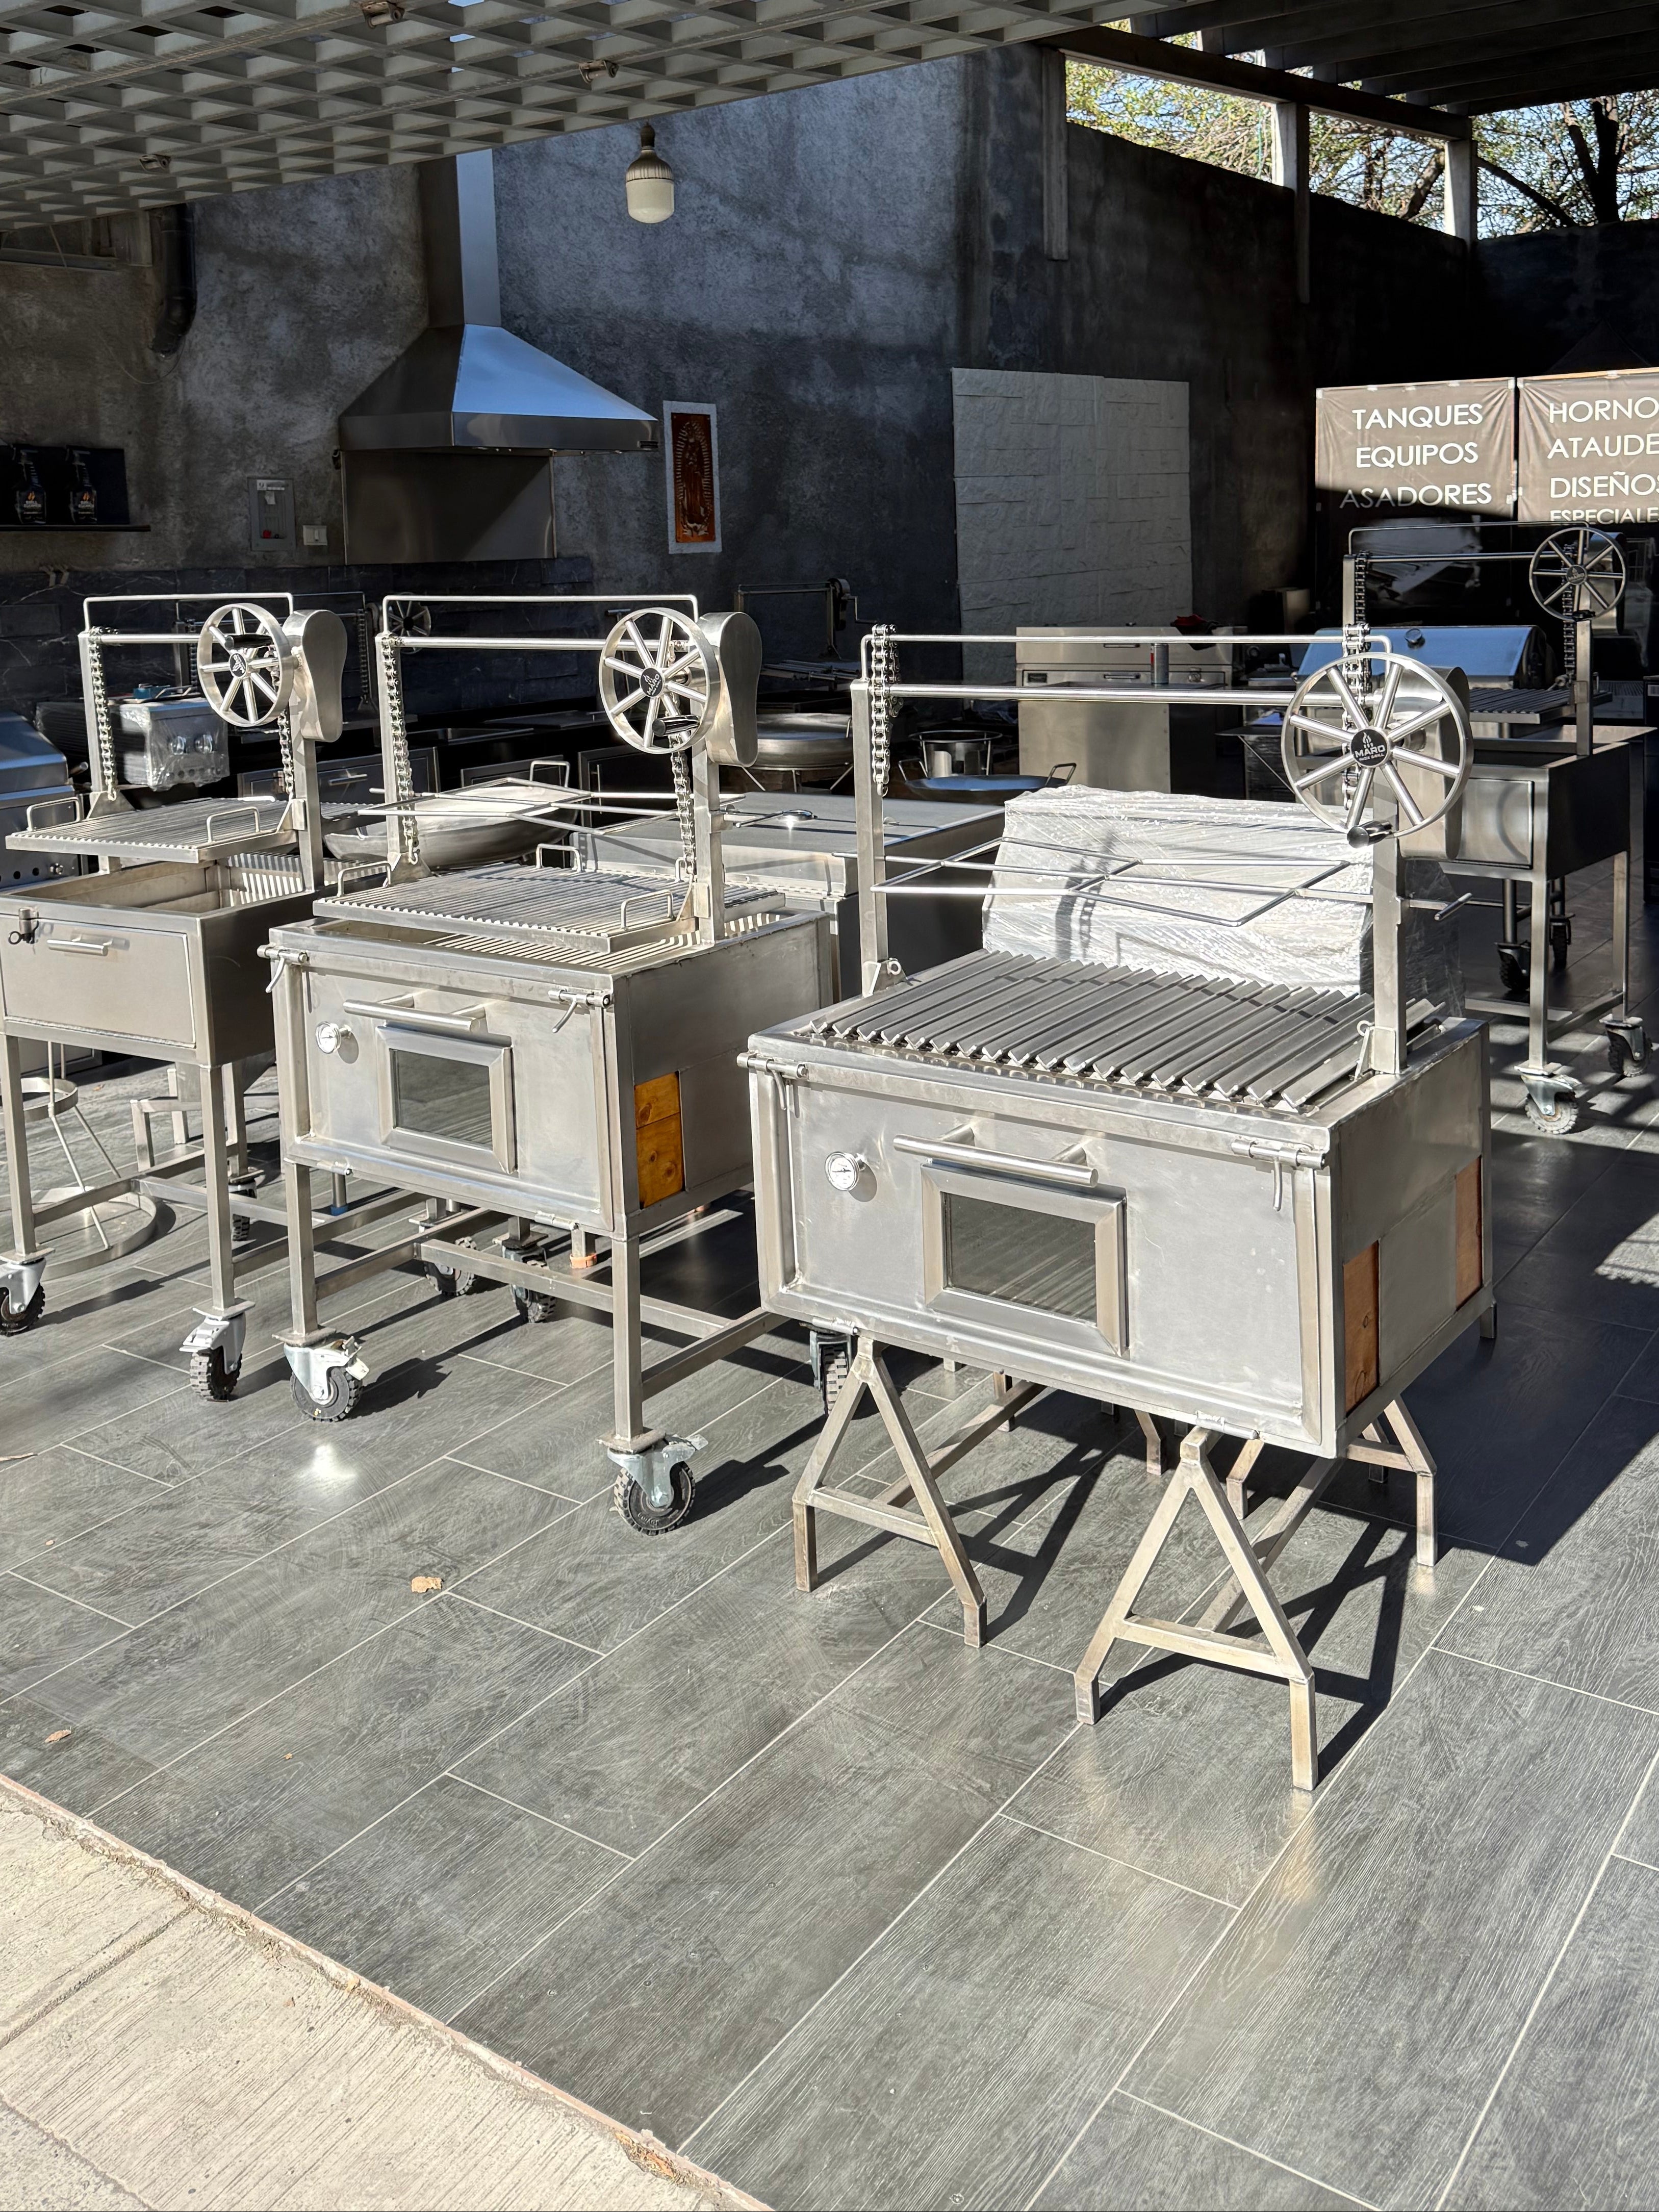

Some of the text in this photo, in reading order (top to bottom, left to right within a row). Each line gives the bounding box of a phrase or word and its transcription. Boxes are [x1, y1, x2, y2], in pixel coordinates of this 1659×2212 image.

[1352, 403, 1484, 430] TANQUES
[1549, 396, 1659, 423] HORNO
[1356, 442, 1479, 468] EQUIPOS
[1547, 433, 1659, 459] ATAUDE
[1339, 482, 1492, 508] ASADORES
[1550, 471, 1659, 498] DISEÑO
[1549, 507, 1659, 525] ESPECIALE
[647, 674, 660, 695] MARO
[1354, 745, 1386, 758] MARO
